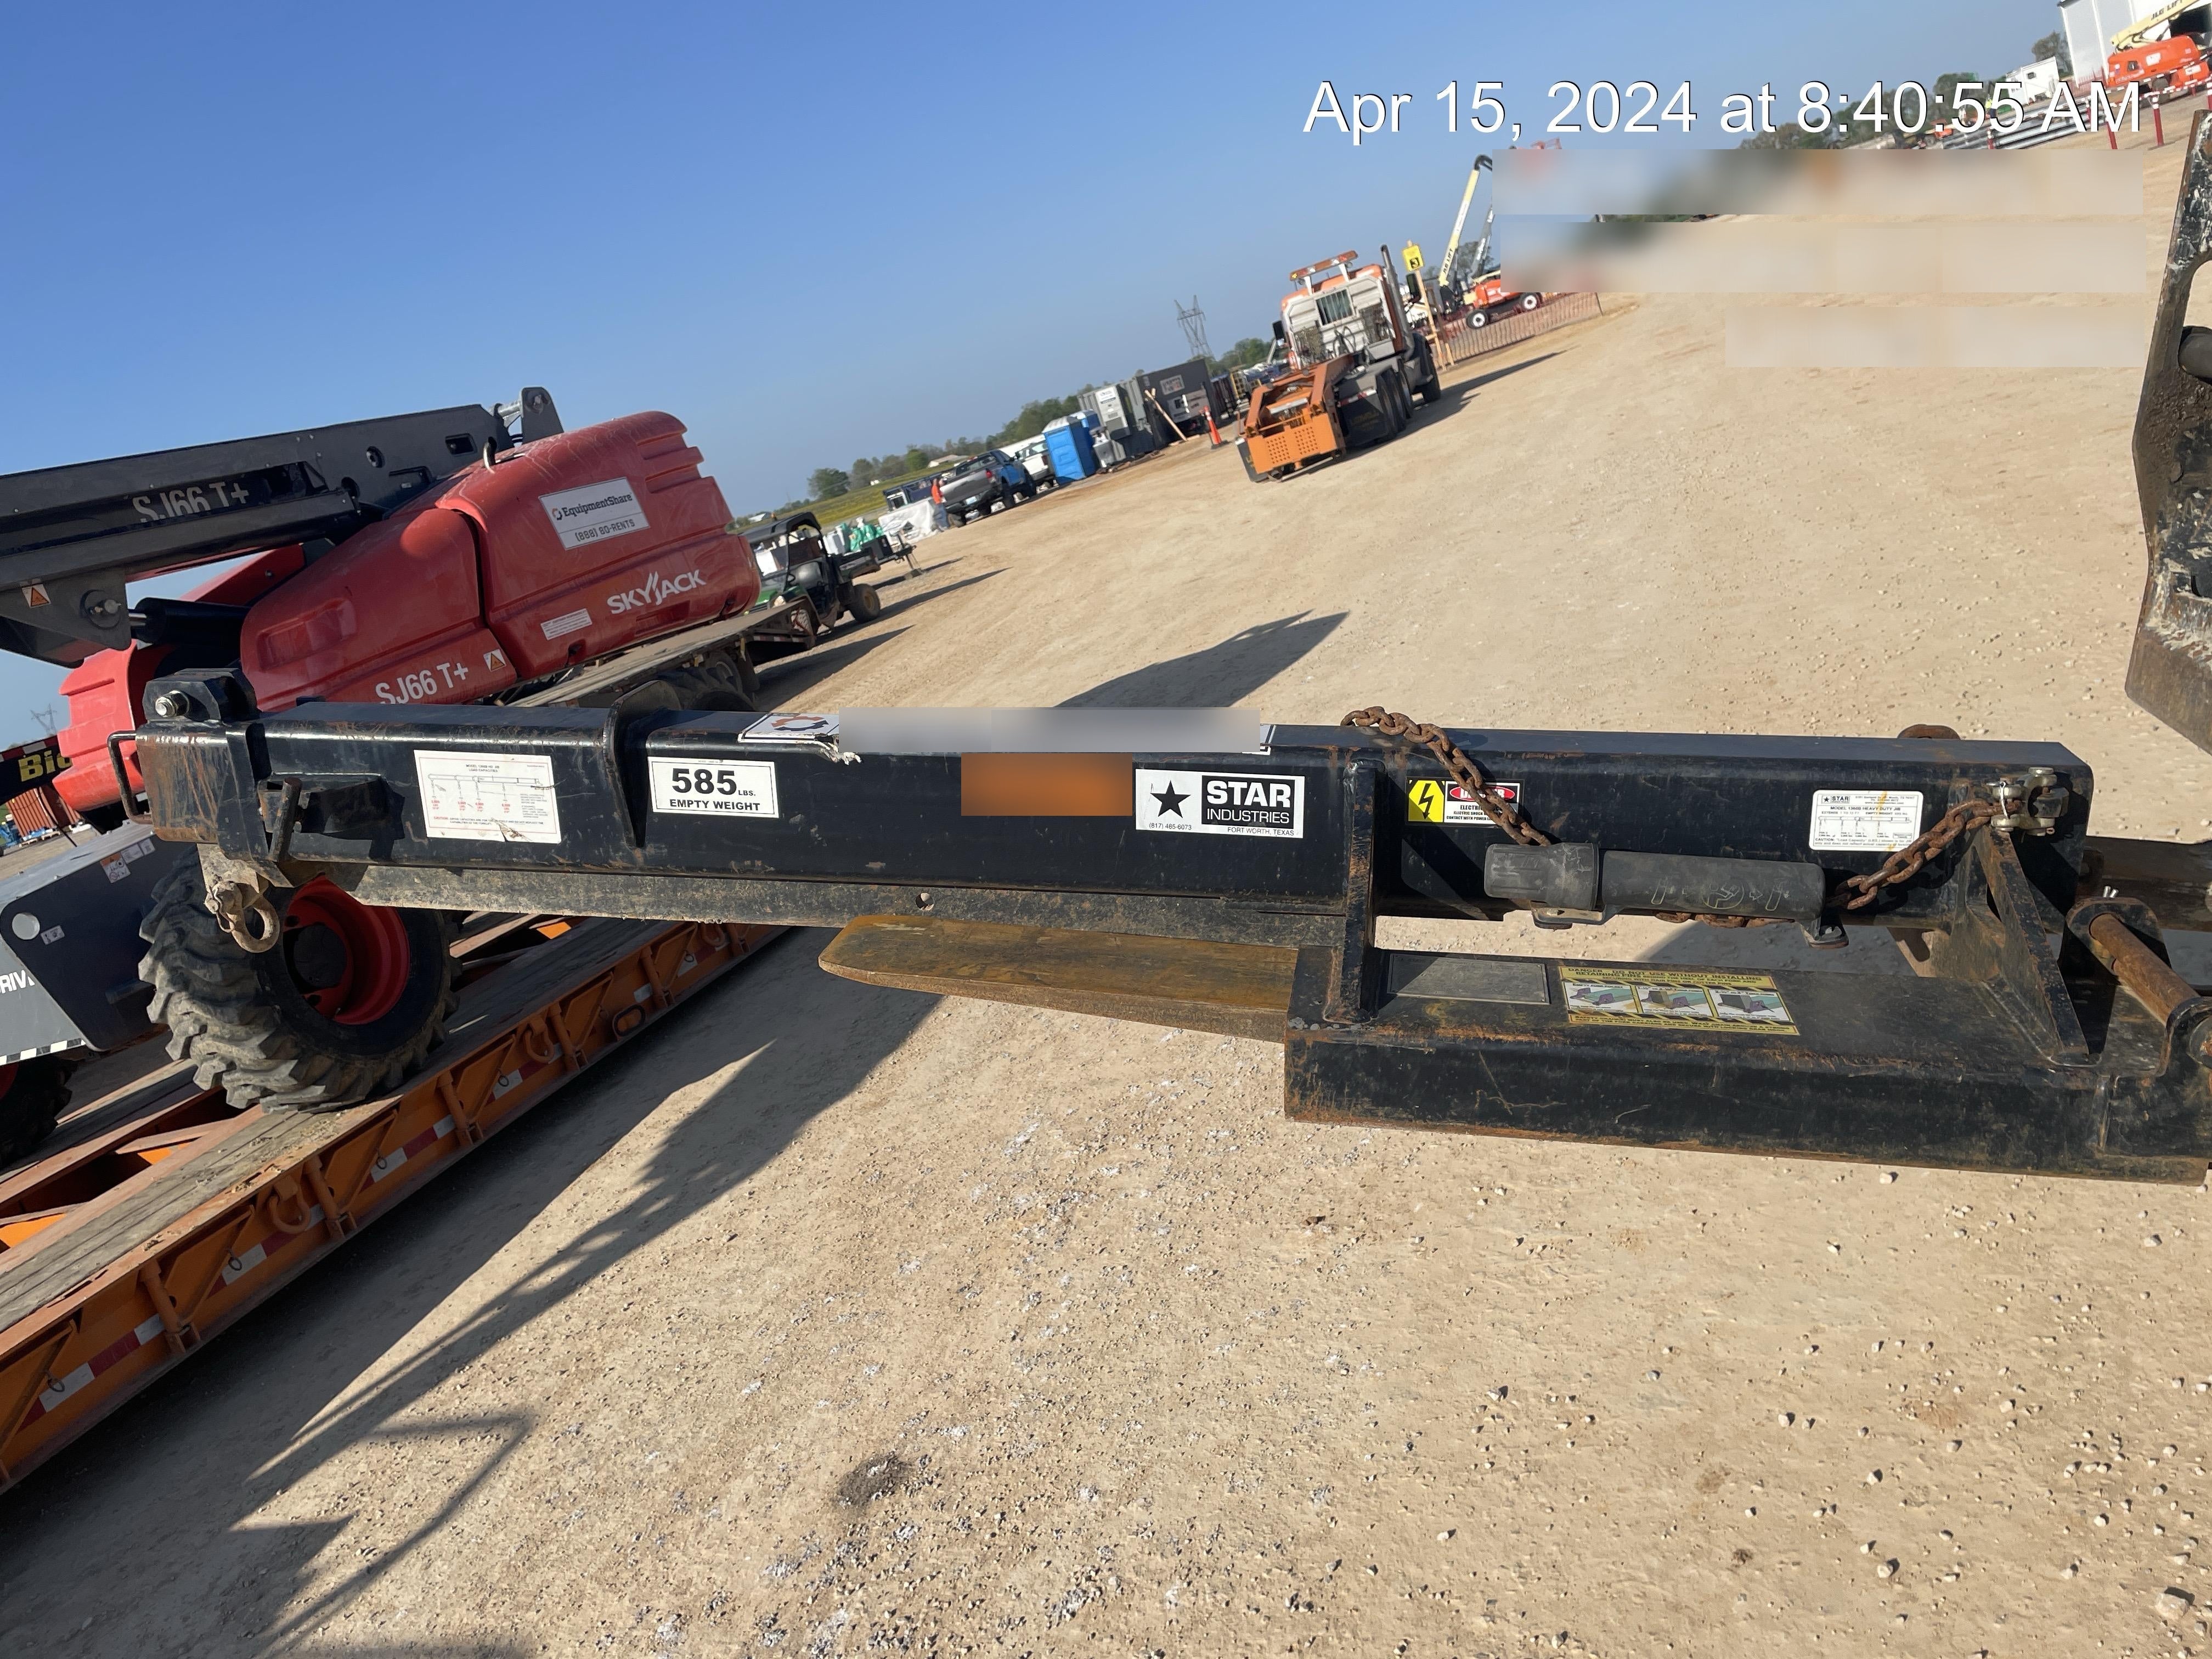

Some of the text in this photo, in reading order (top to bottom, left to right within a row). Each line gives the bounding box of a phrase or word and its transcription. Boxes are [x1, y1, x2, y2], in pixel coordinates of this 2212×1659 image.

[209, 482, 249, 507] T+
[562, 493, 633, 517] EquipmentShare
[574, 518, 635, 542] (888) 80-RENTS
[607, 569, 707, 614] SKYJACK
[375, 662, 469, 704] SJ66 T+
[672, 768, 737, 795] 585
[1206, 780, 1291, 808] STAR
[669, 799, 760, 811] EMPTY WEIGHT
[1207, 808, 1289, 823] INDUSTRIES
